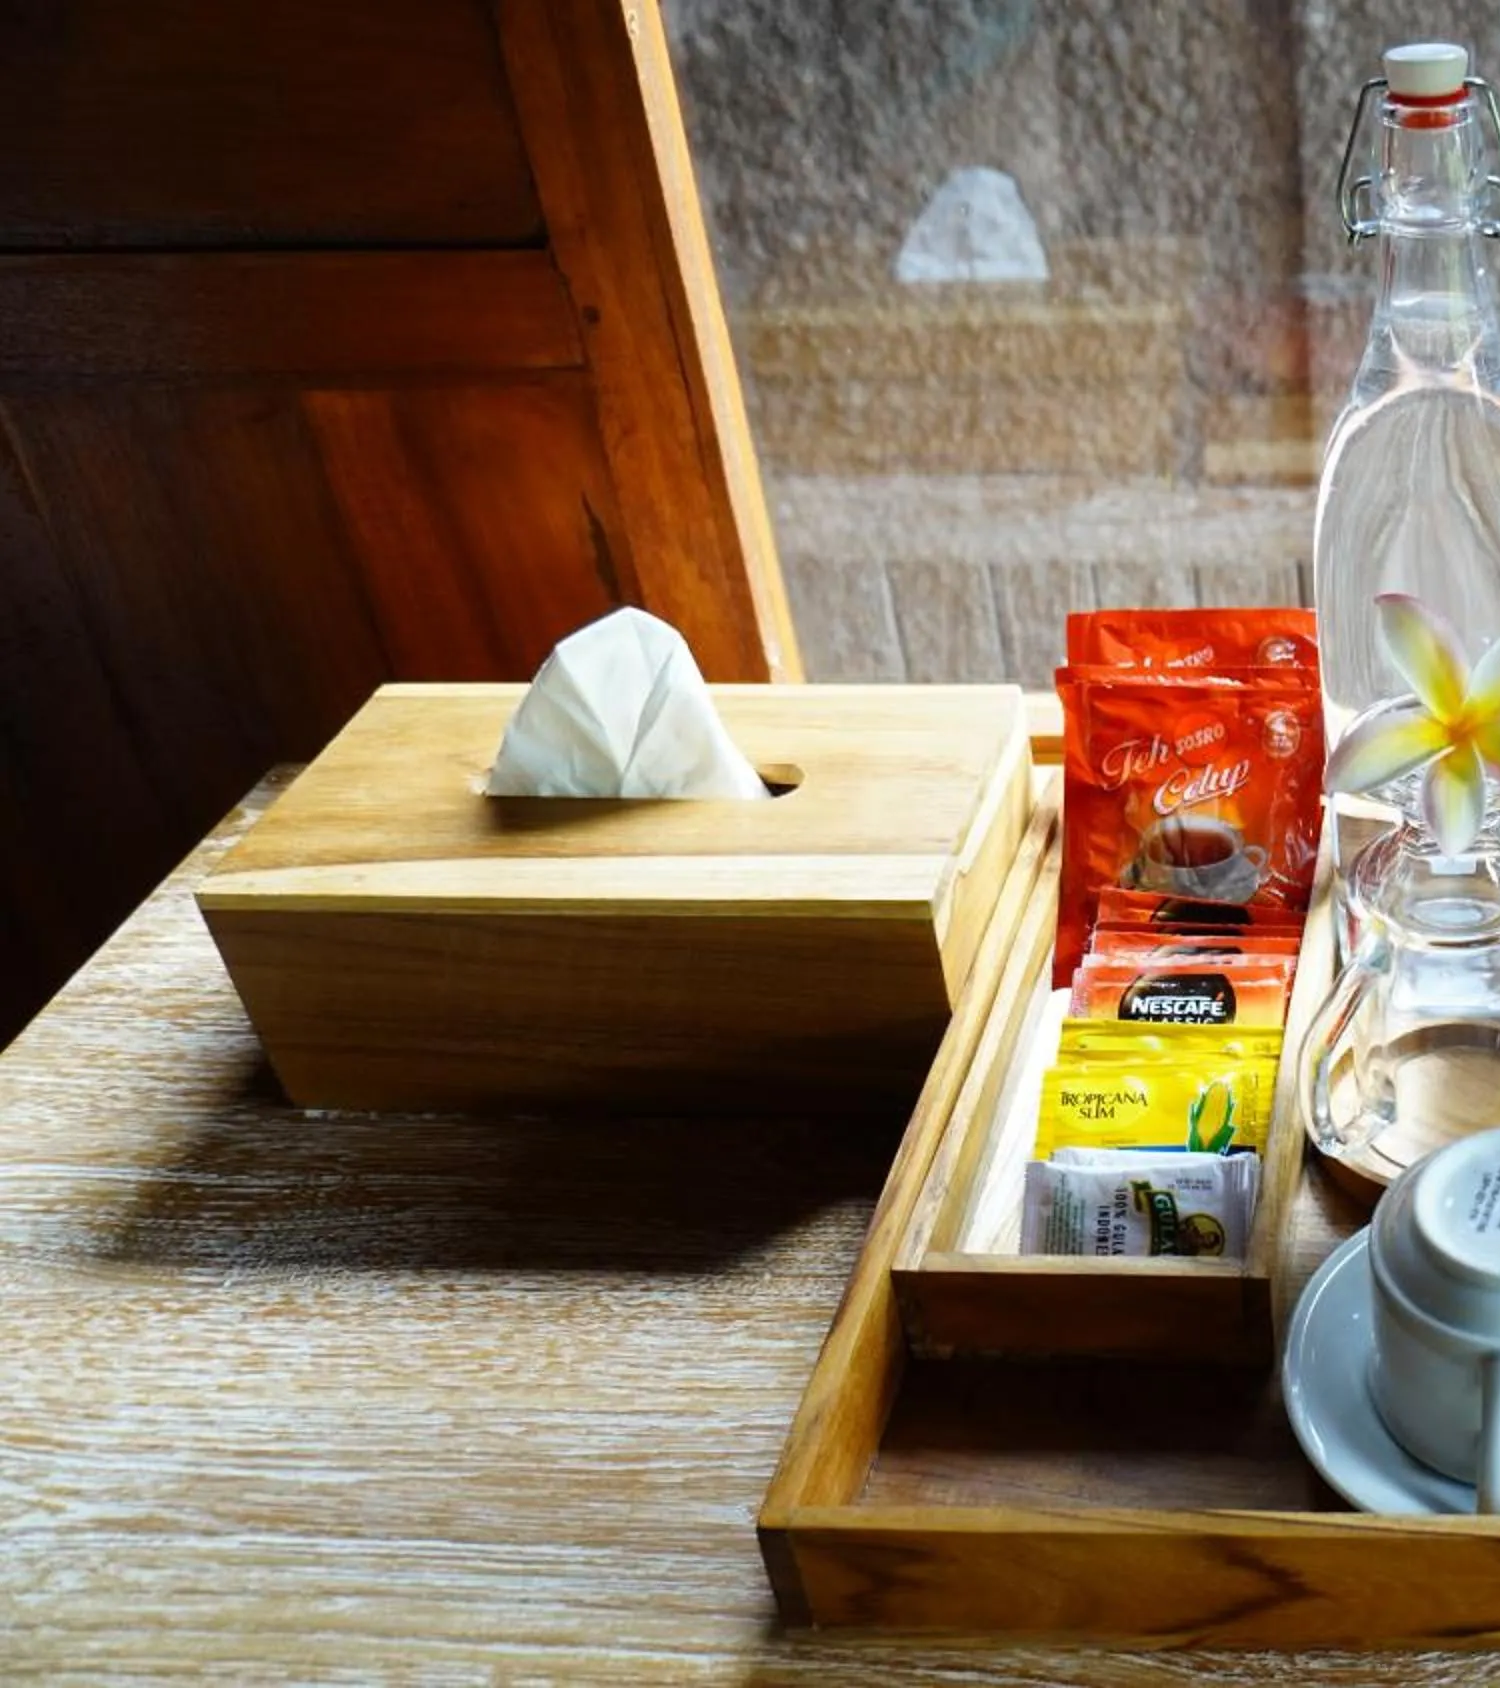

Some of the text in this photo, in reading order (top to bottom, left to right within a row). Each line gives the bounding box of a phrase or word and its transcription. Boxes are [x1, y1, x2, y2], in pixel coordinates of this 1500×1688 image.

[1101, 733, 1169, 791] Teh
[1175, 722, 1225, 755] SOSRO
[1153, 759, 1250, 815] Celup
[1060, 1091, 1148, 1108] TROPICANA
[1079, 1105, 1115, 1119] SLIM
[1096, 1205, 1110, 1256] INDONE
[1112, 1188, 1127, 1255] 100% GULA
